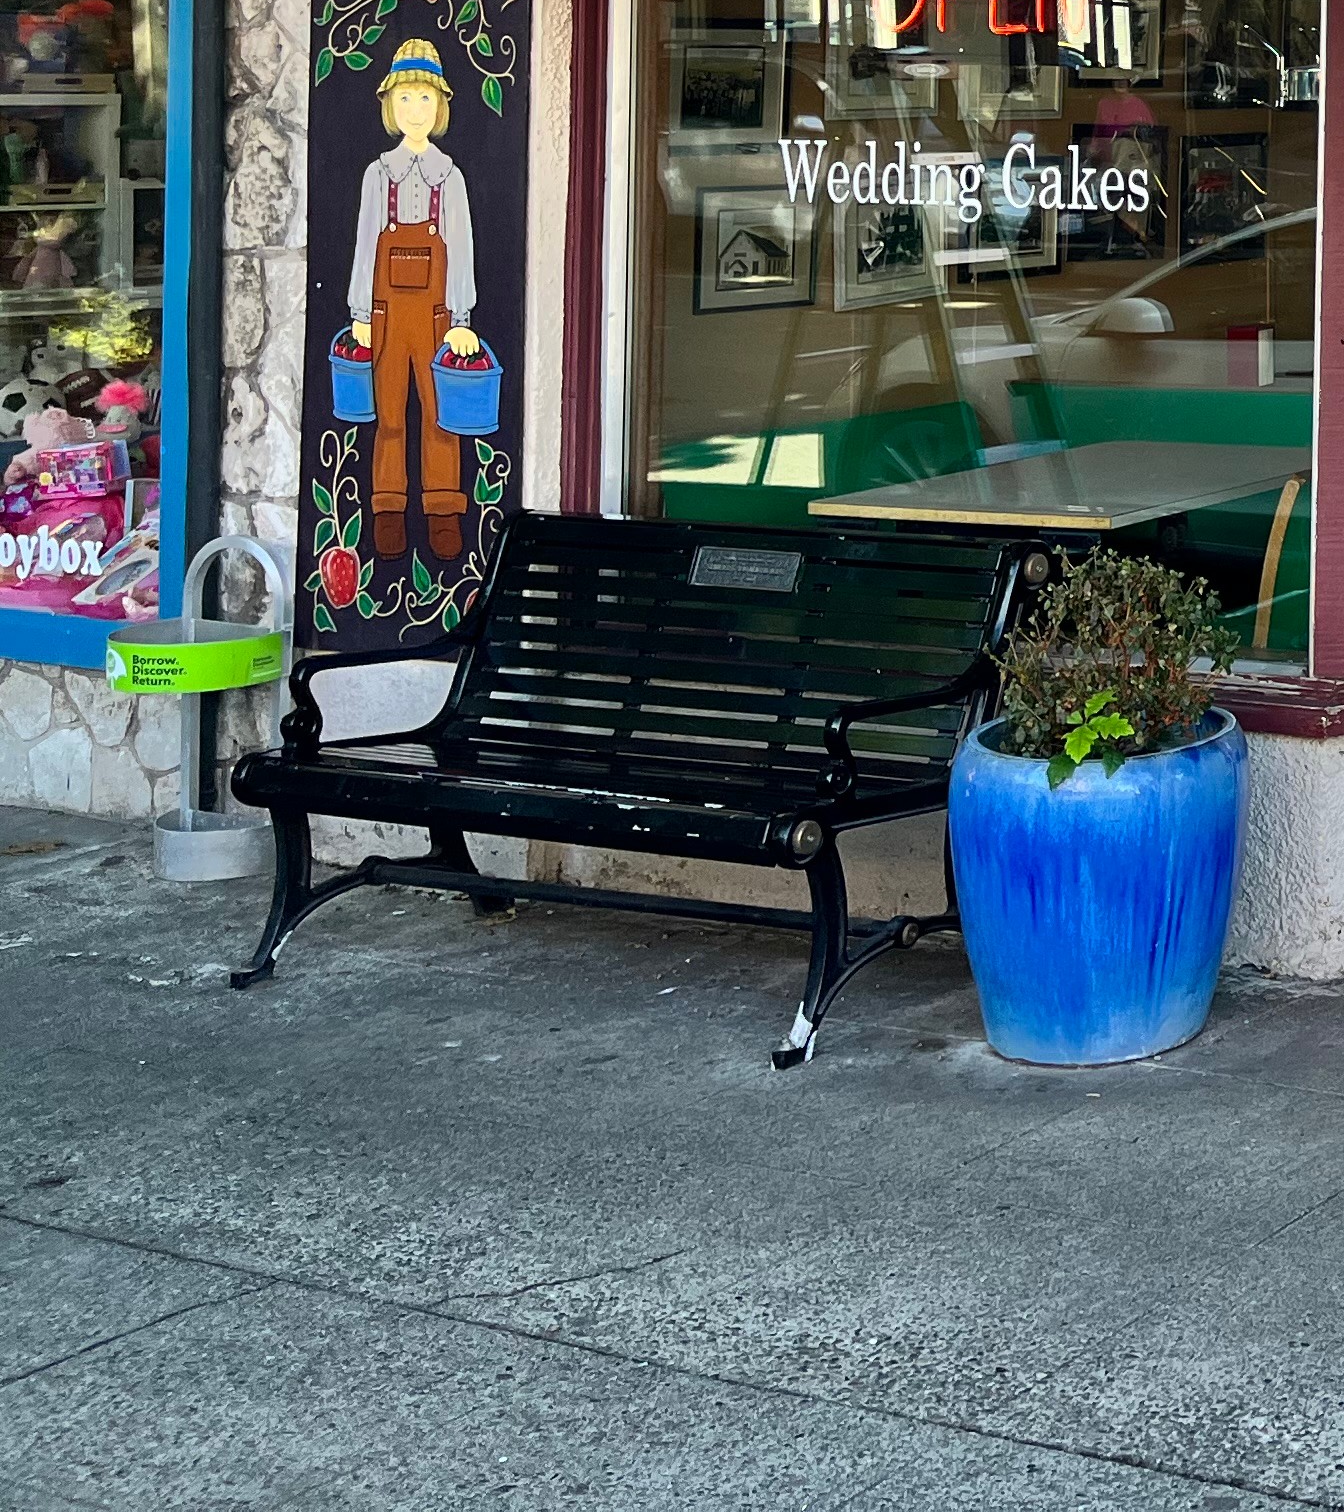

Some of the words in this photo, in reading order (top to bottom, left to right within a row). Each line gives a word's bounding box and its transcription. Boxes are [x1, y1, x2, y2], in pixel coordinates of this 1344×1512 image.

[777, 138, 985, 223] Wedding
[1001, 142, 1151, 212] Cakes
[0, 524, 104, 581] oybox
